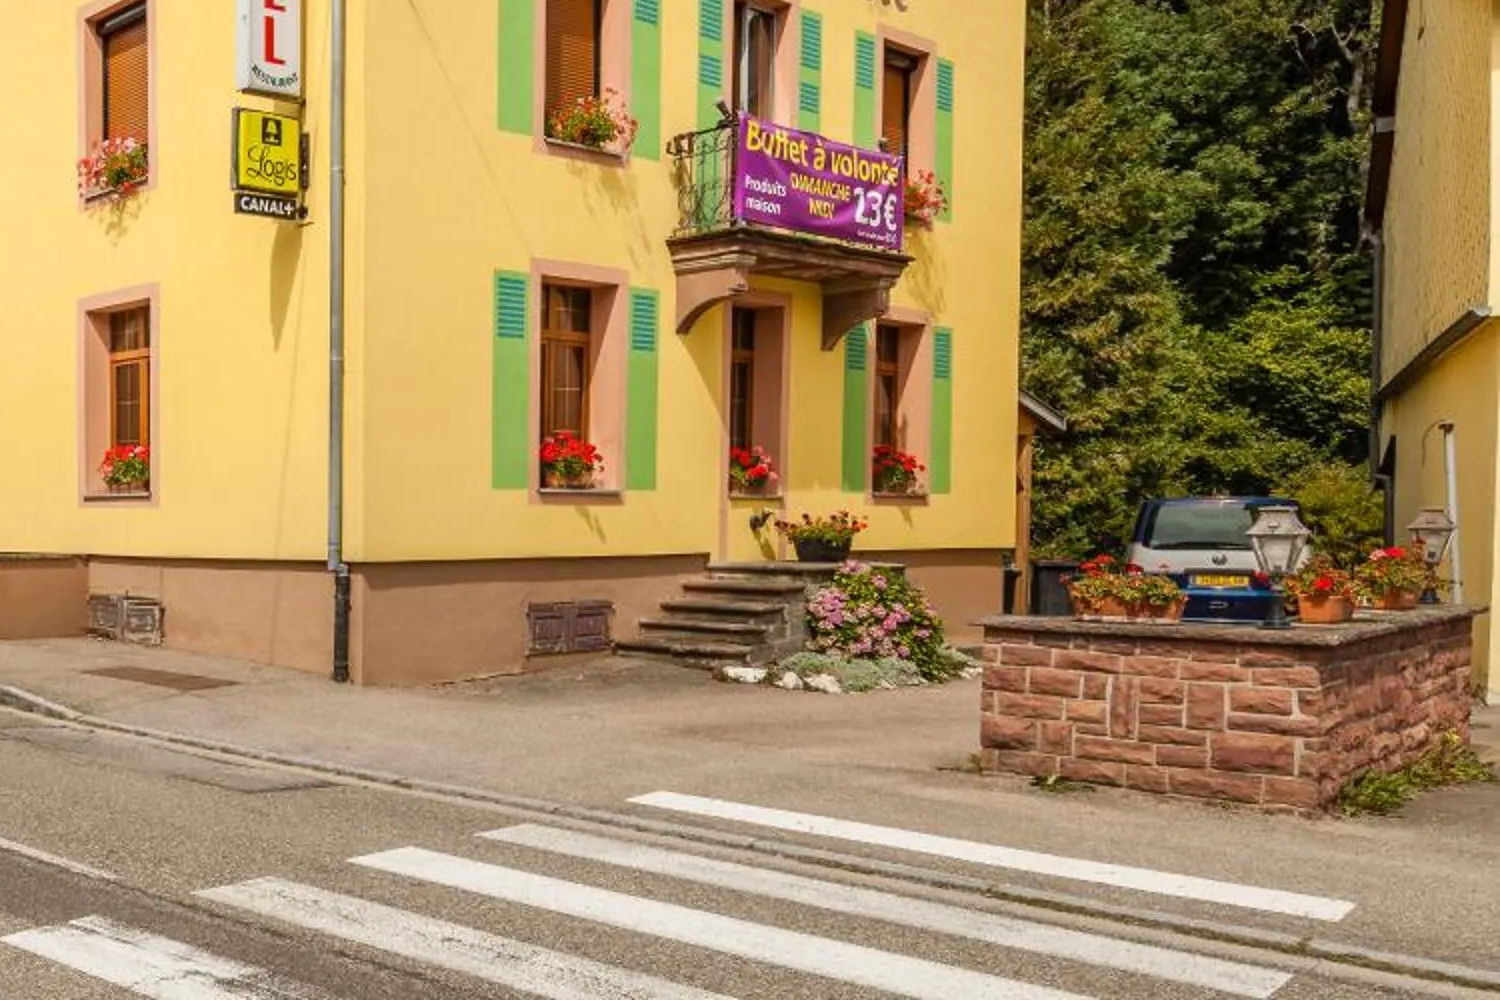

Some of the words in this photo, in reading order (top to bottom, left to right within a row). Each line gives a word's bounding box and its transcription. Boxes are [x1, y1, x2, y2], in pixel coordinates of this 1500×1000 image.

[245, 145, 297, 187] Logis
[746, 119, 809, 167] Buffet
[813, 135, 826, 171] à
[831, 150, 900, 187] volonté
[744, 174, 787, 197] Produits
[789, 172, 851, 201] DIMANCHE
[240, 197, 295, 216] CANAL+
[746, 197, 781, 215] maison
[853, 186, 898, 231] 23€
